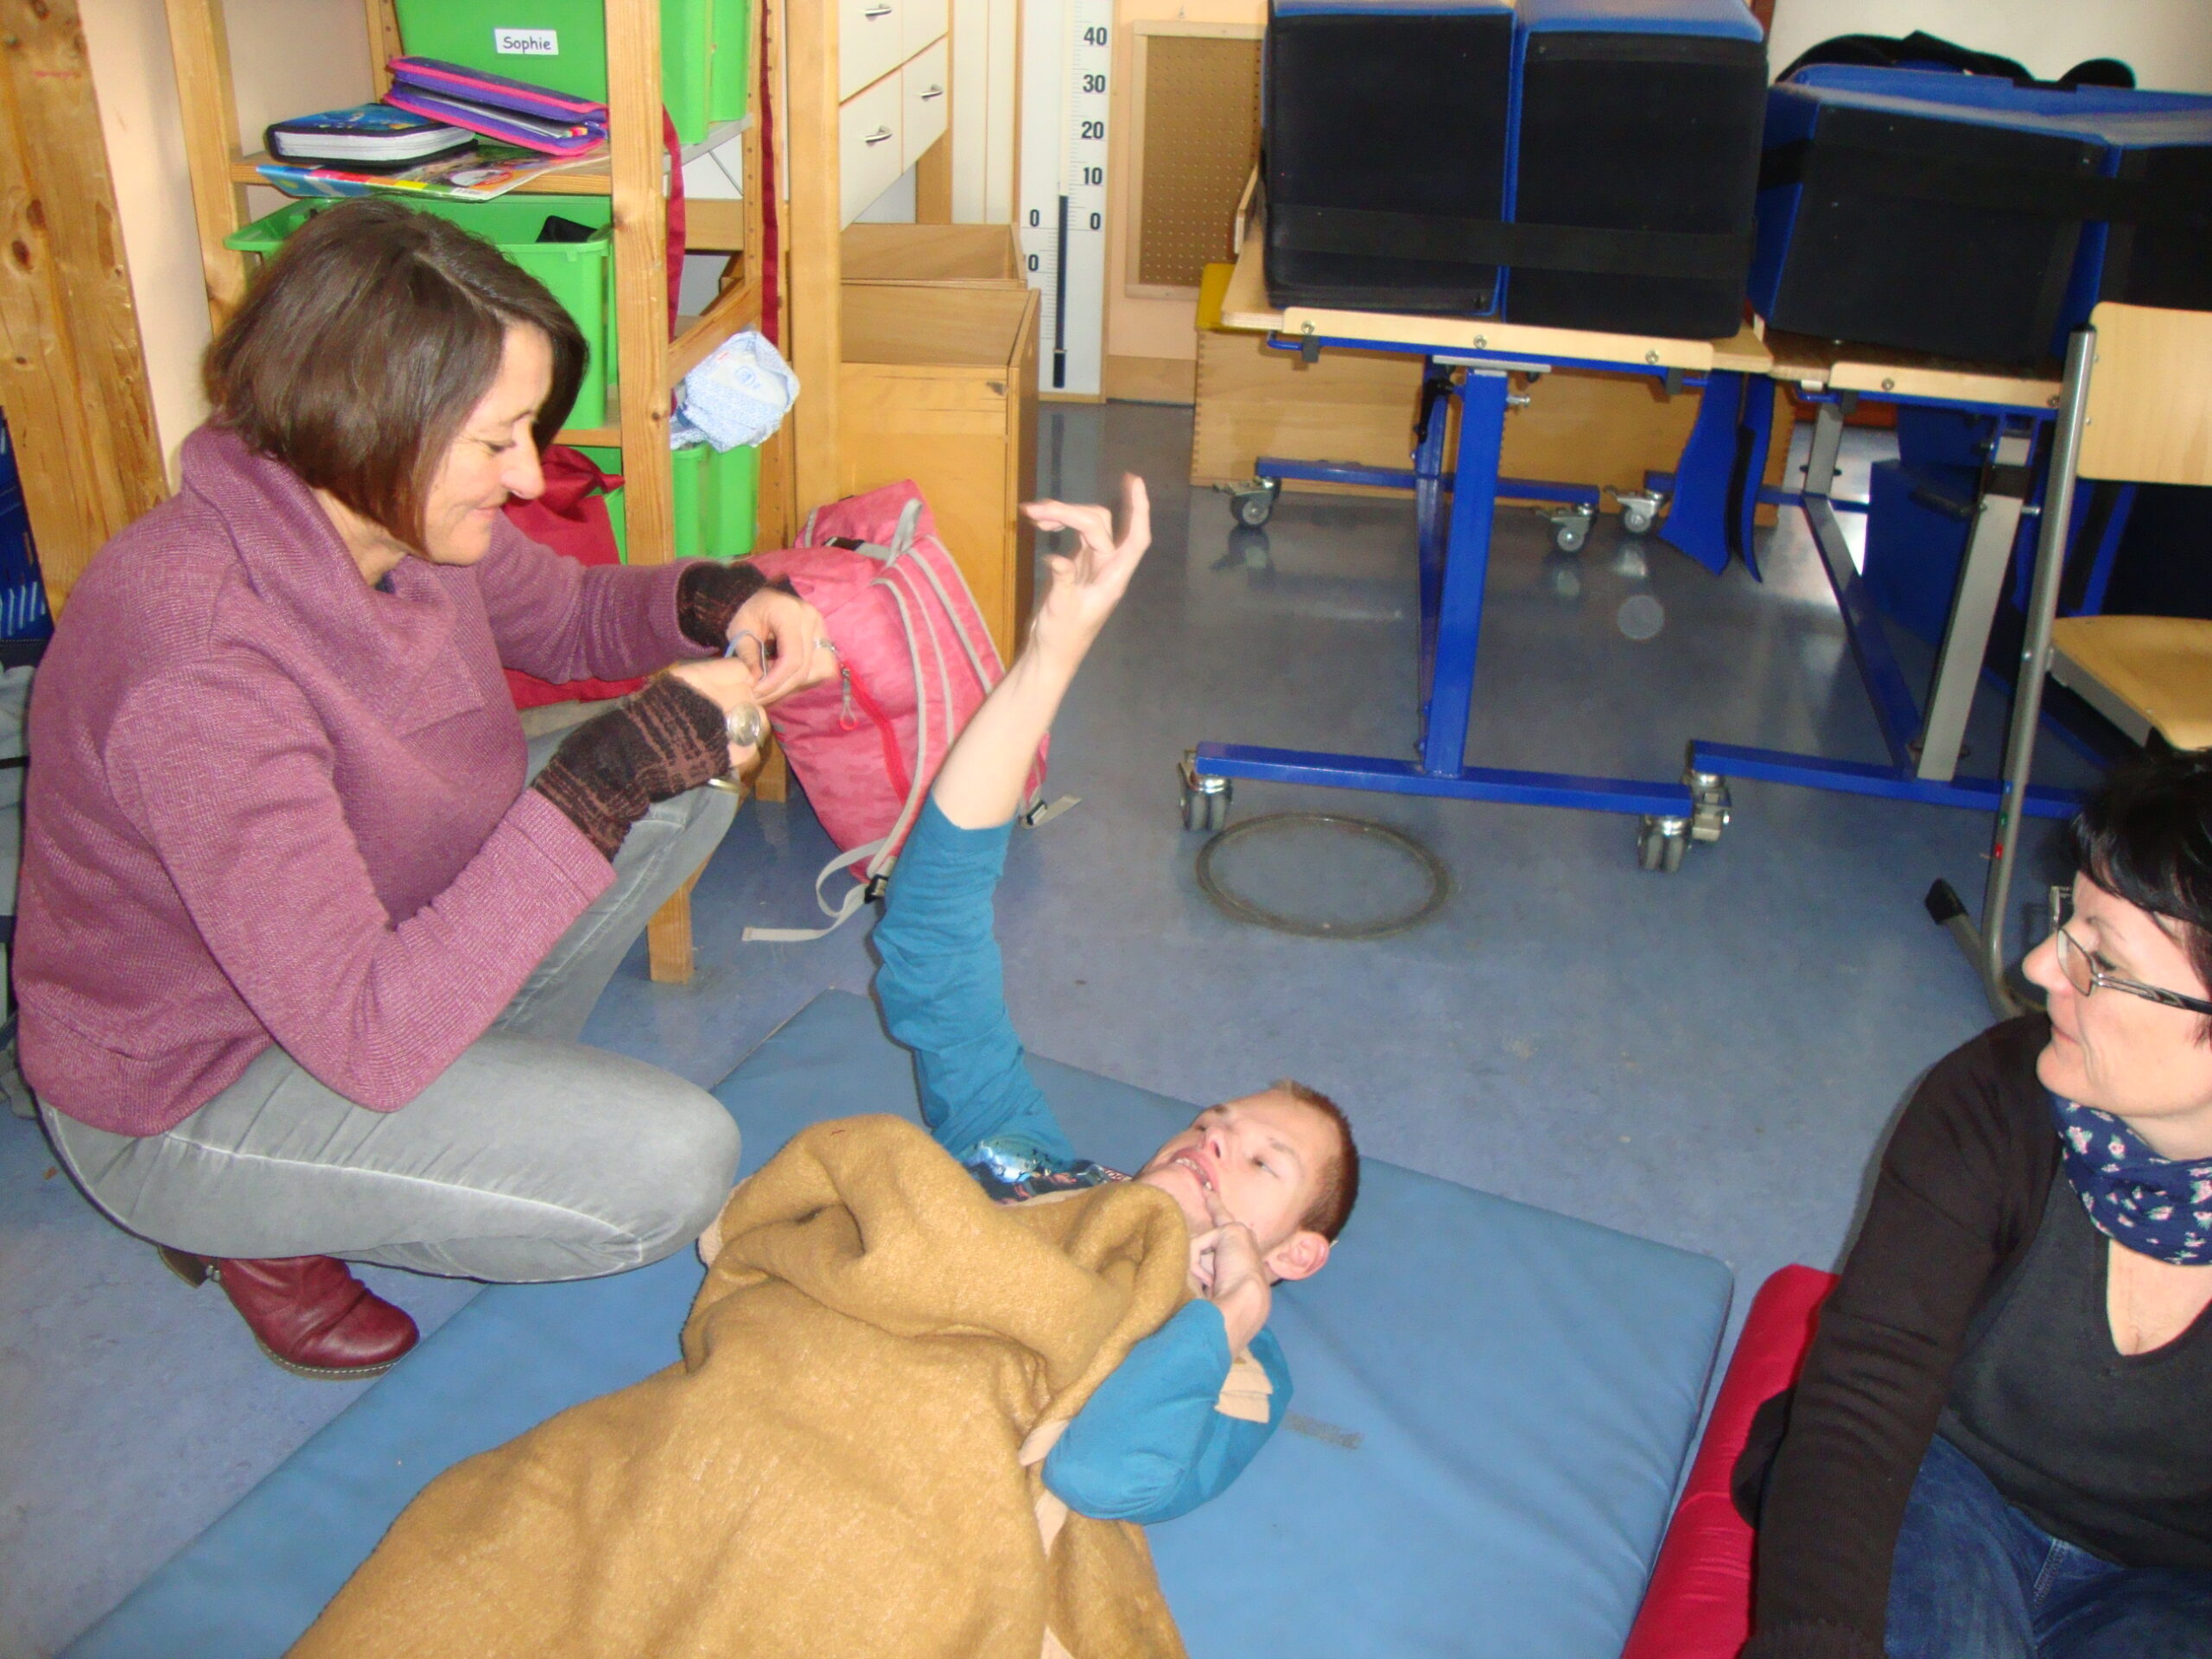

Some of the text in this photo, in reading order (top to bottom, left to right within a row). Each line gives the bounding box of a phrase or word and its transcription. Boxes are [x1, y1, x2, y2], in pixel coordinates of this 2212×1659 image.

[503, 36, 552, 54] Sophie
[1084, 27, 1108, 46] 40
[1083, 74, 1106, 93] 30
[1081, 121, 1104, 139] 20
[1084, 167, 1103, 185] 10
[1030, 209, 1039, 226] 0
[1090, 213, 1101, 230] 0
